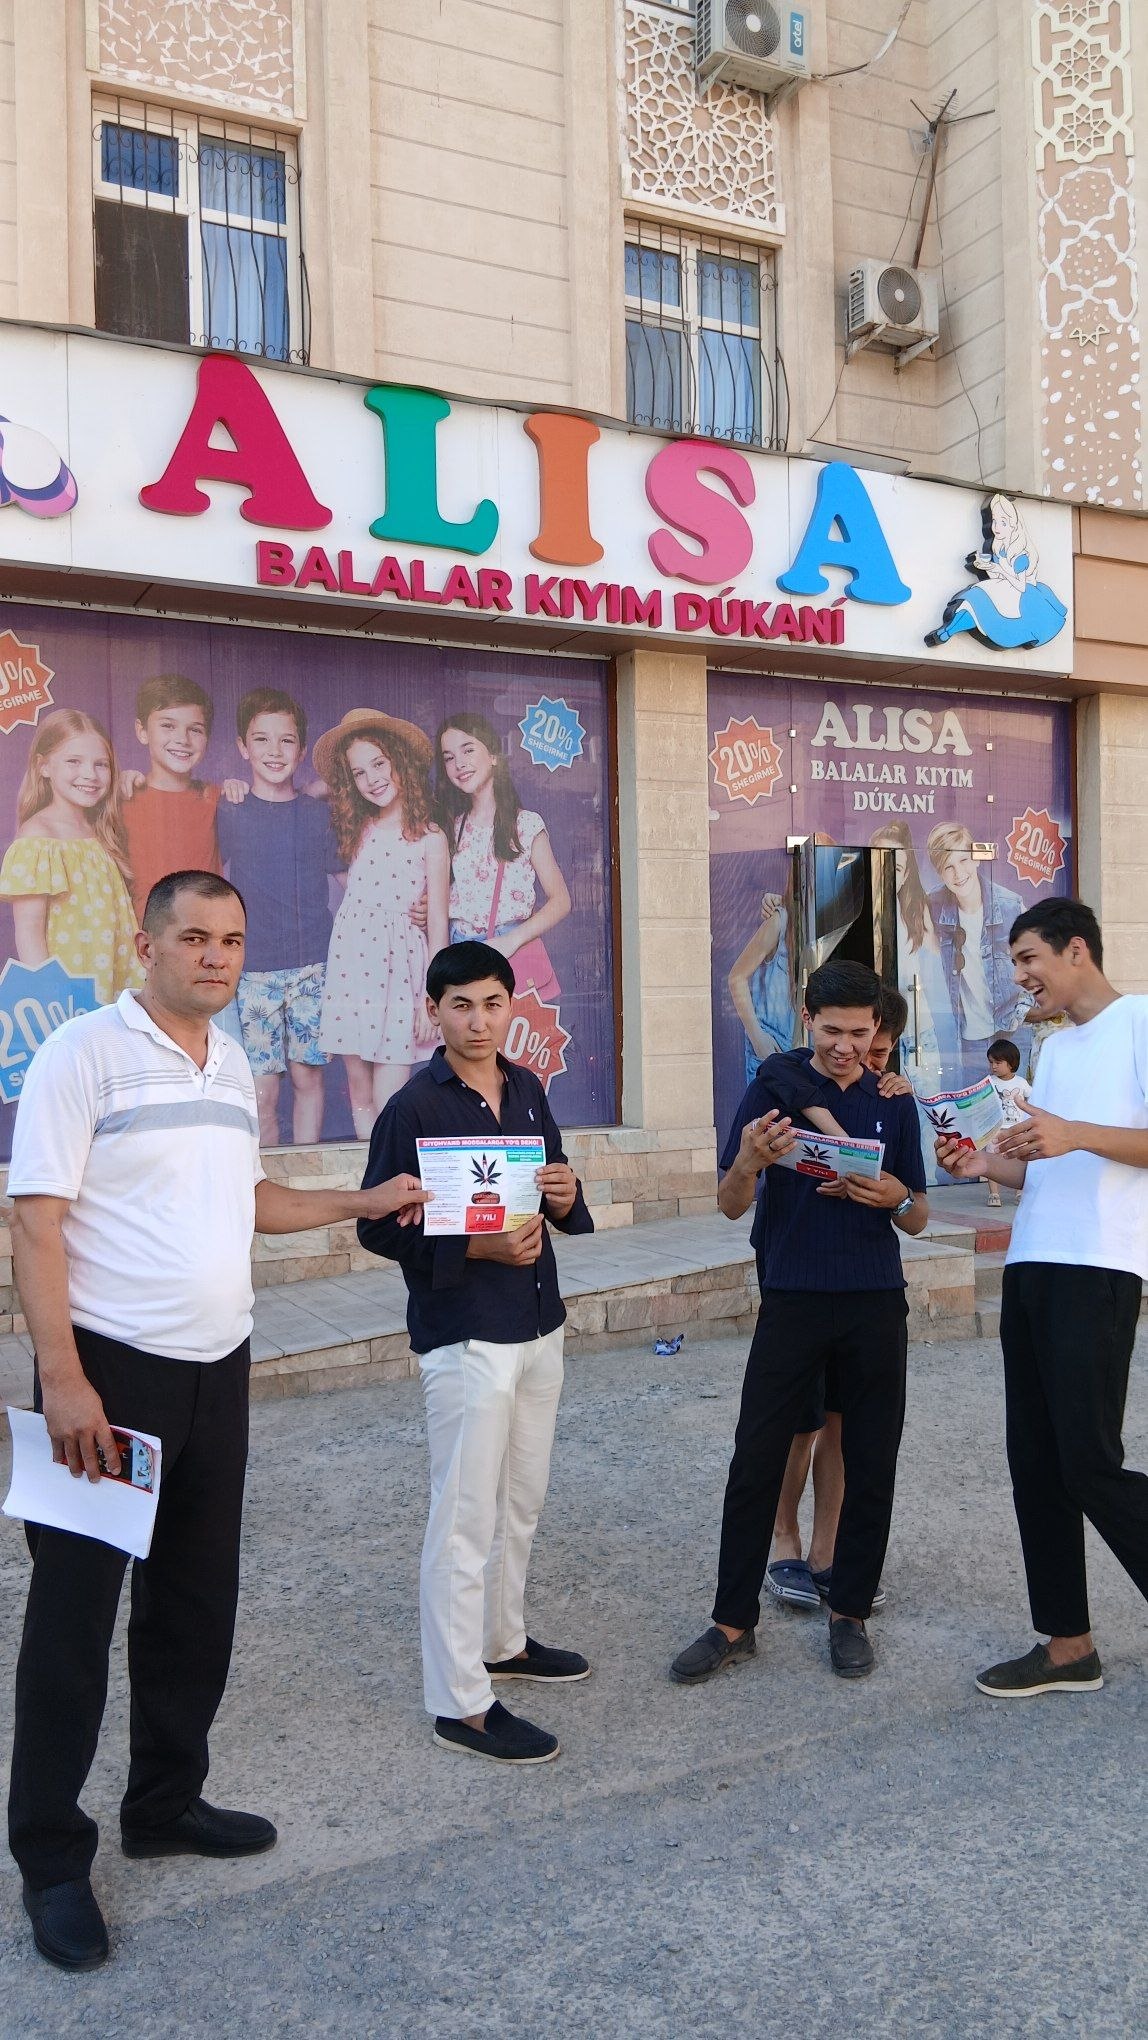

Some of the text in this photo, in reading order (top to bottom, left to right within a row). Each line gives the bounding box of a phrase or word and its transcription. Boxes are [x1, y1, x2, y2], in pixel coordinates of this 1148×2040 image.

[792, 20, 802, 48] artel
[138, 354, 914, 607] ALISA
[255, 540, 848, 646] BALALAR KIYIM DÚKANÍ
[529, 709, 574, 751] 20%
[810, 701, 973, 756] ALISA
[527, 737, 570, 761] SHEGIRME
[719, 739, 772, 781] 20%
[731, 765, 776, 792] SHEGIRME
[810, 759, 974, 789] BALALAR KIYIM
[853, 786, 936, 815] DÚKANÍ
[1015, 821, 1056, 866] 20%
[1013, 852, 1052, 876] SHEGIRME
[504, 1016, 552, 1070] 0%
[475, 1213, 481, 1222] 7
